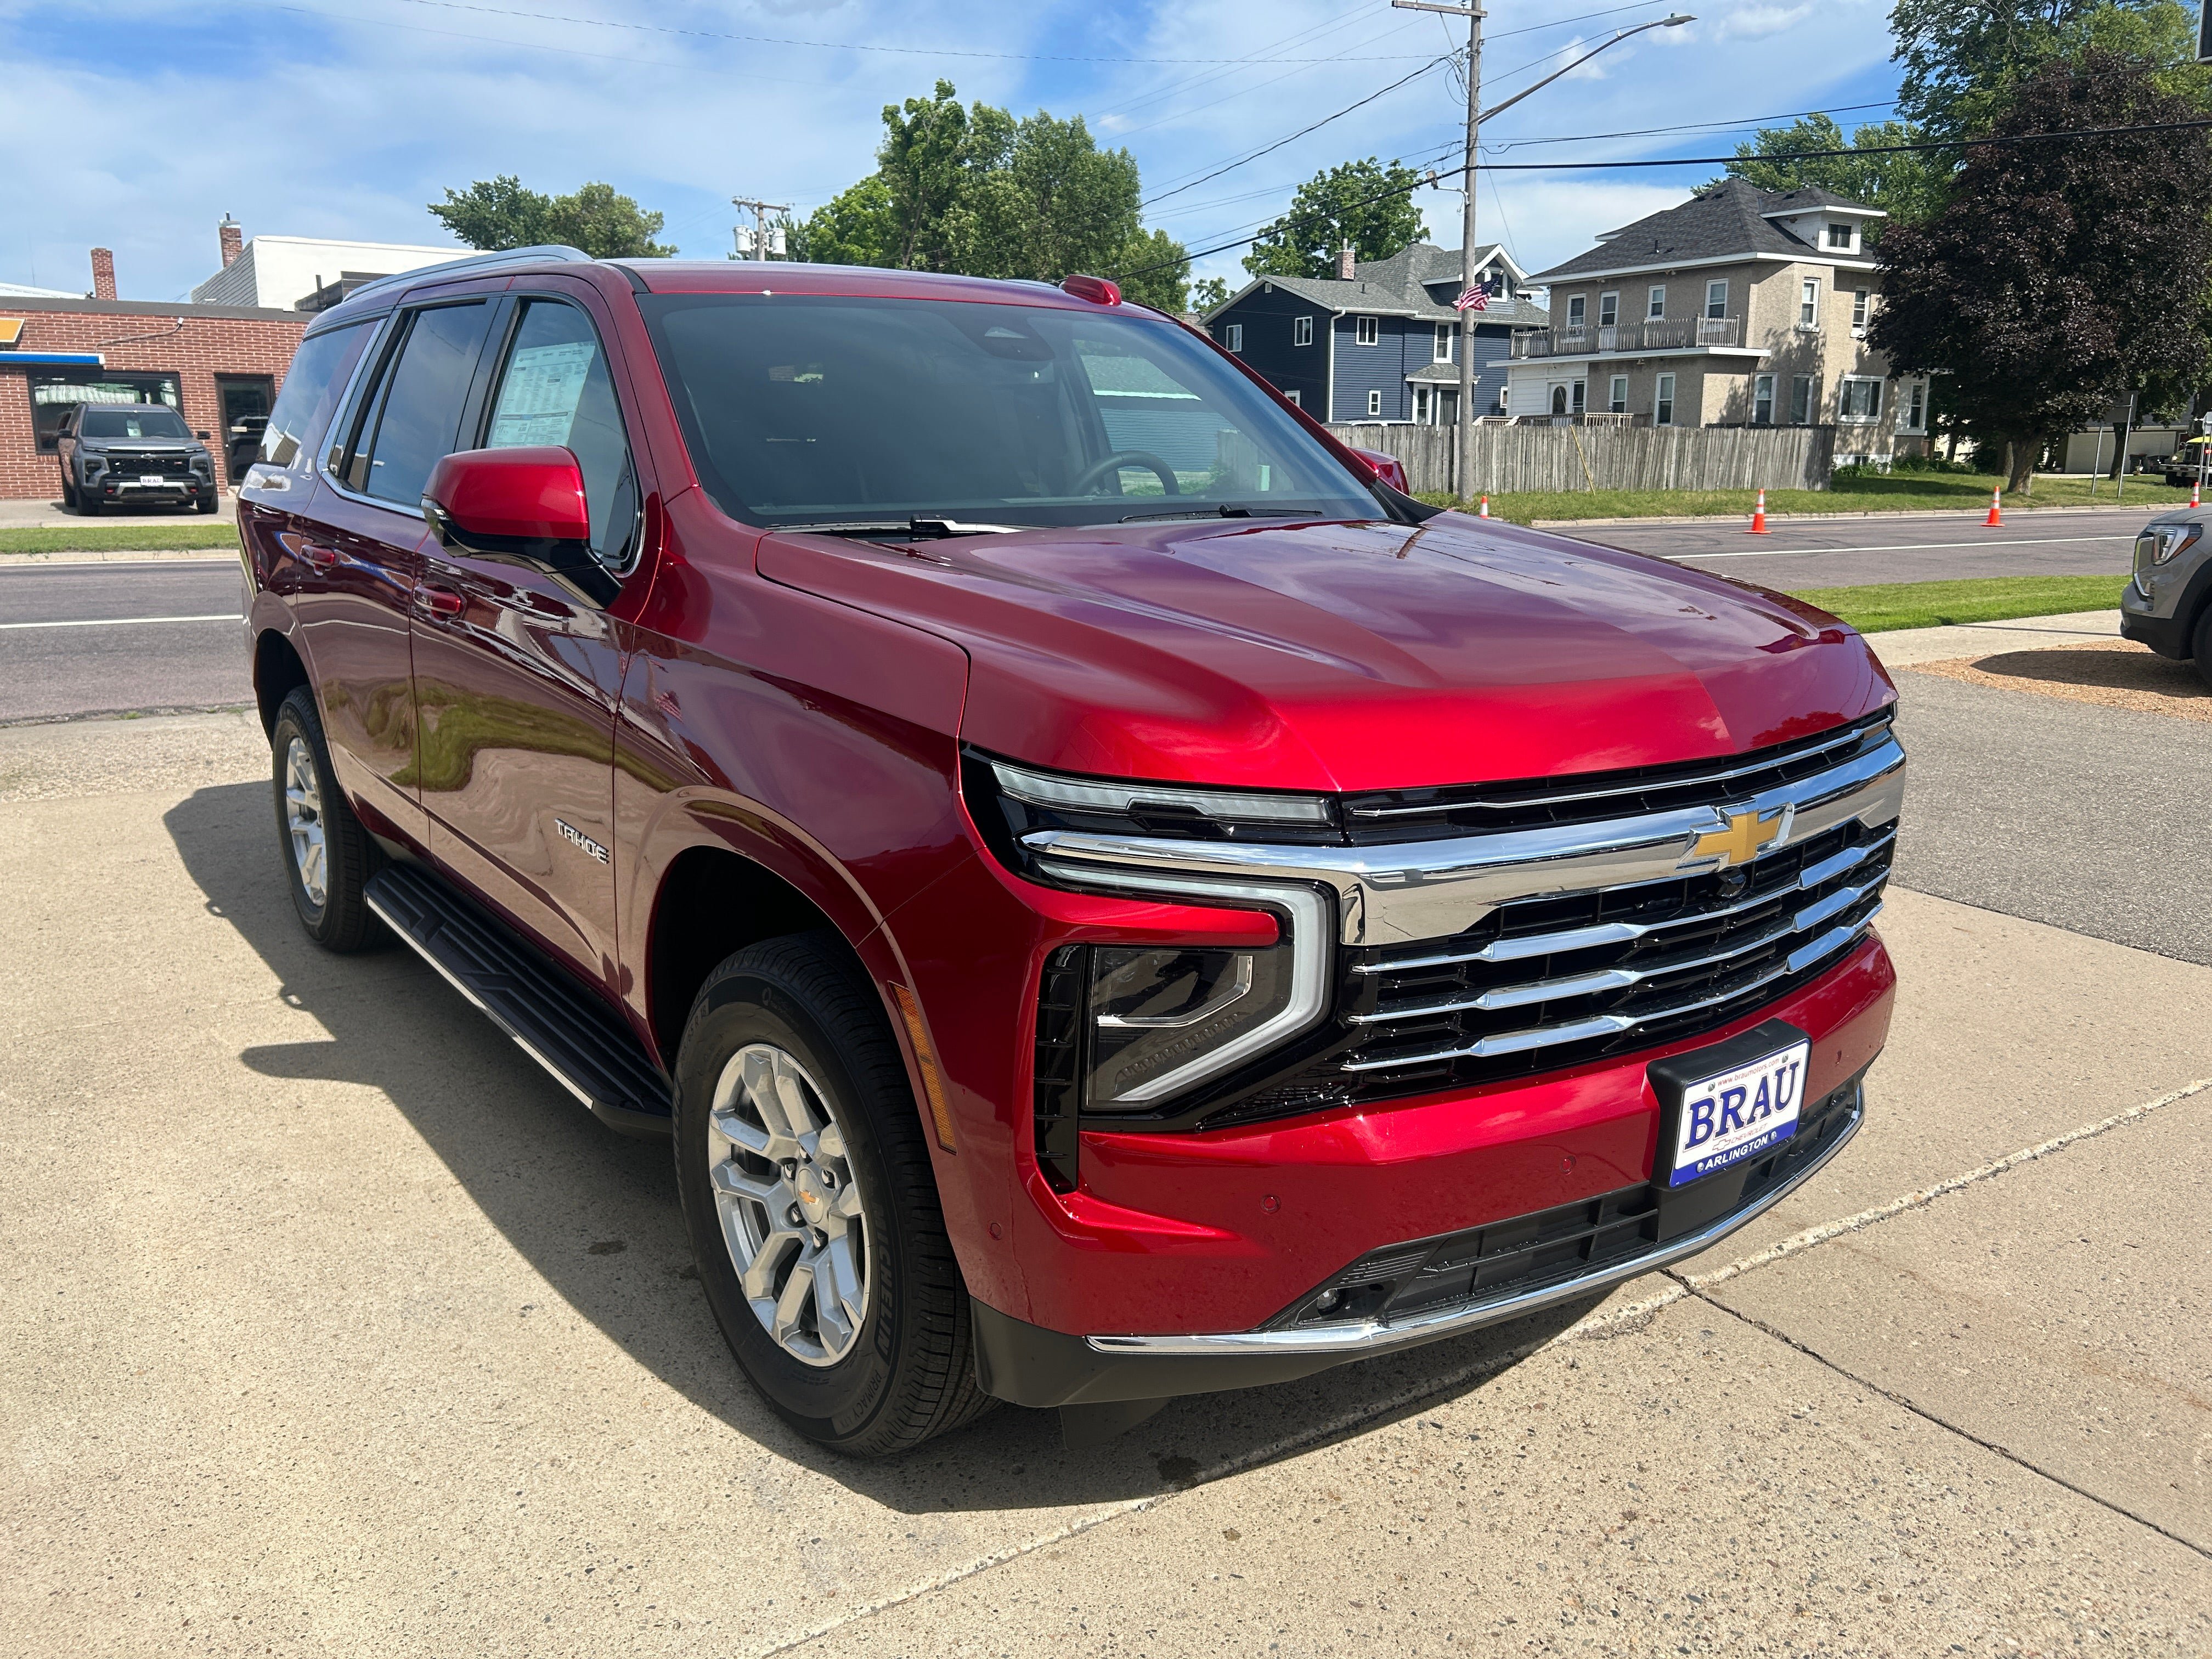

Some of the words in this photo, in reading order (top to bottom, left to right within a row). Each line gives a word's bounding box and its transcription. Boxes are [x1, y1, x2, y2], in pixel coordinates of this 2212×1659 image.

[555, 818, 610, 865] TAHOE
[1717, 1058, 1780, 1087] www.braumotors.com
[1683, 1059, 1801, 1153] BRAU
[1705, 1134, 1768, 1170] ARLINGTON
[1731, 1123, 1768, 1144] CHEVROLET
[873, 1203, 893, 1361] MICHELIN
[852, 1369, 882, 1420] PRIMACY
